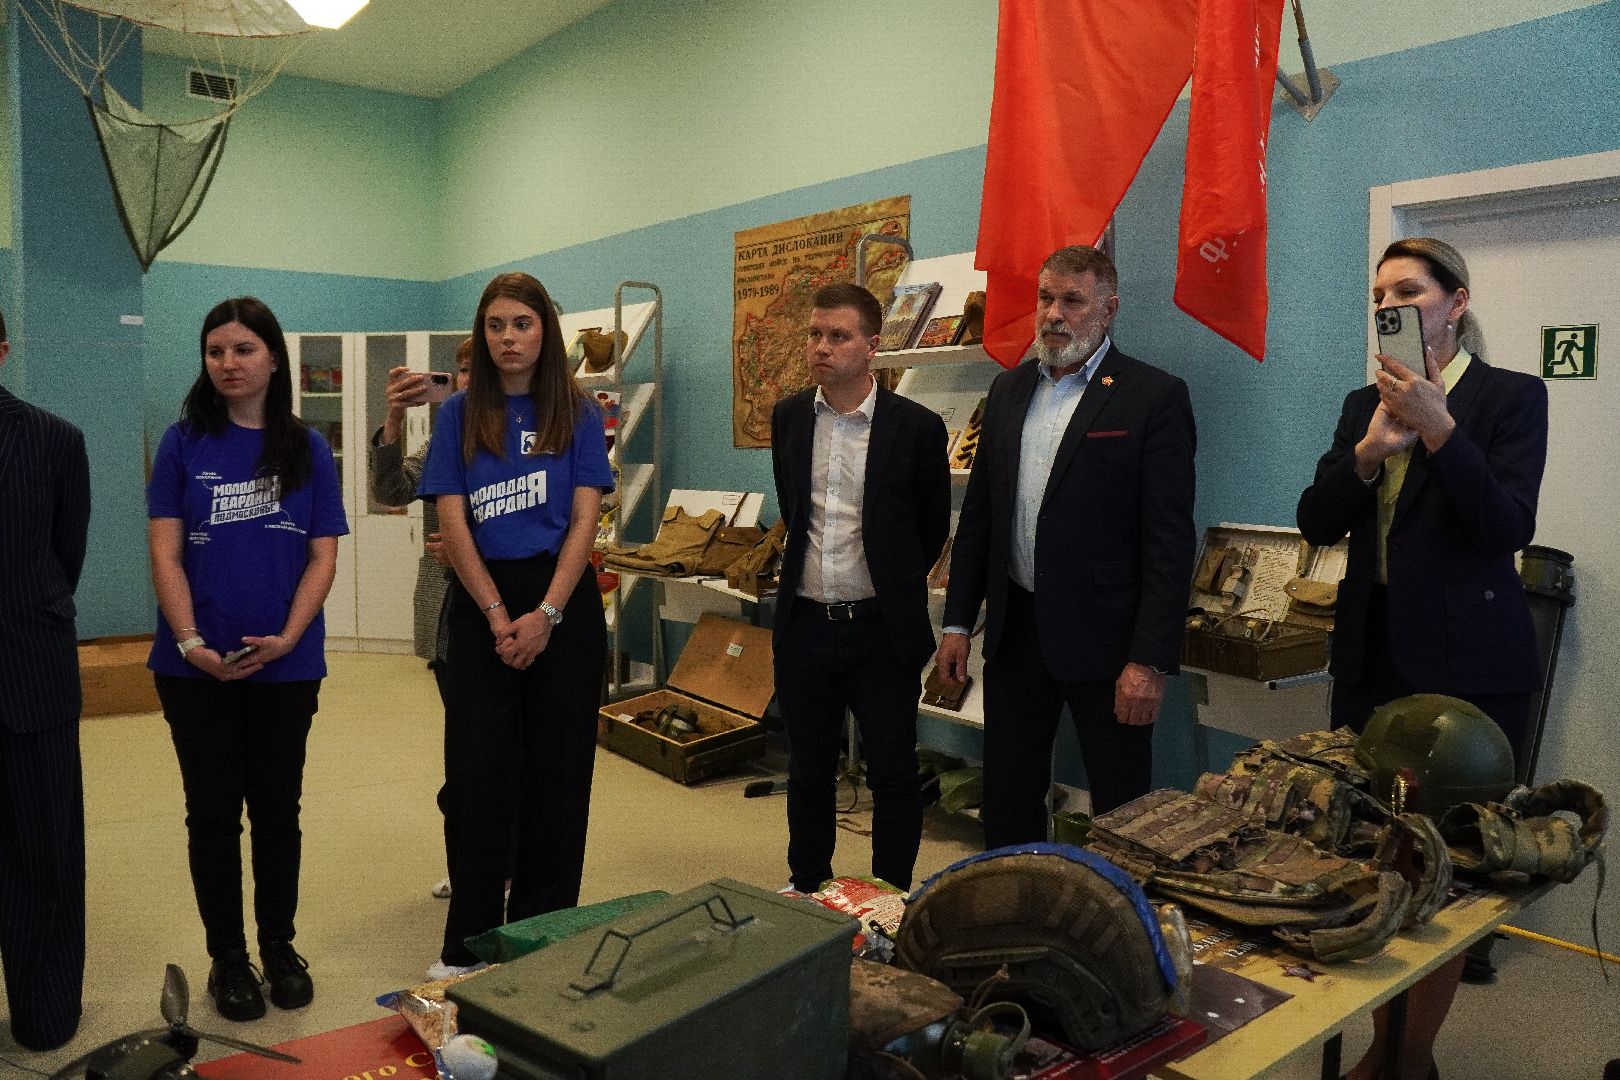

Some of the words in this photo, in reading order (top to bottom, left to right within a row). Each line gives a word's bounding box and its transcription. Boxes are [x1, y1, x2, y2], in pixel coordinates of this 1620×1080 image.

[737, 246, 768, 261] КАРТА
[772, 232, 843, 257] ДИСЛОКАЦИИ
[737, 284, 779, 300] 1979-1989
